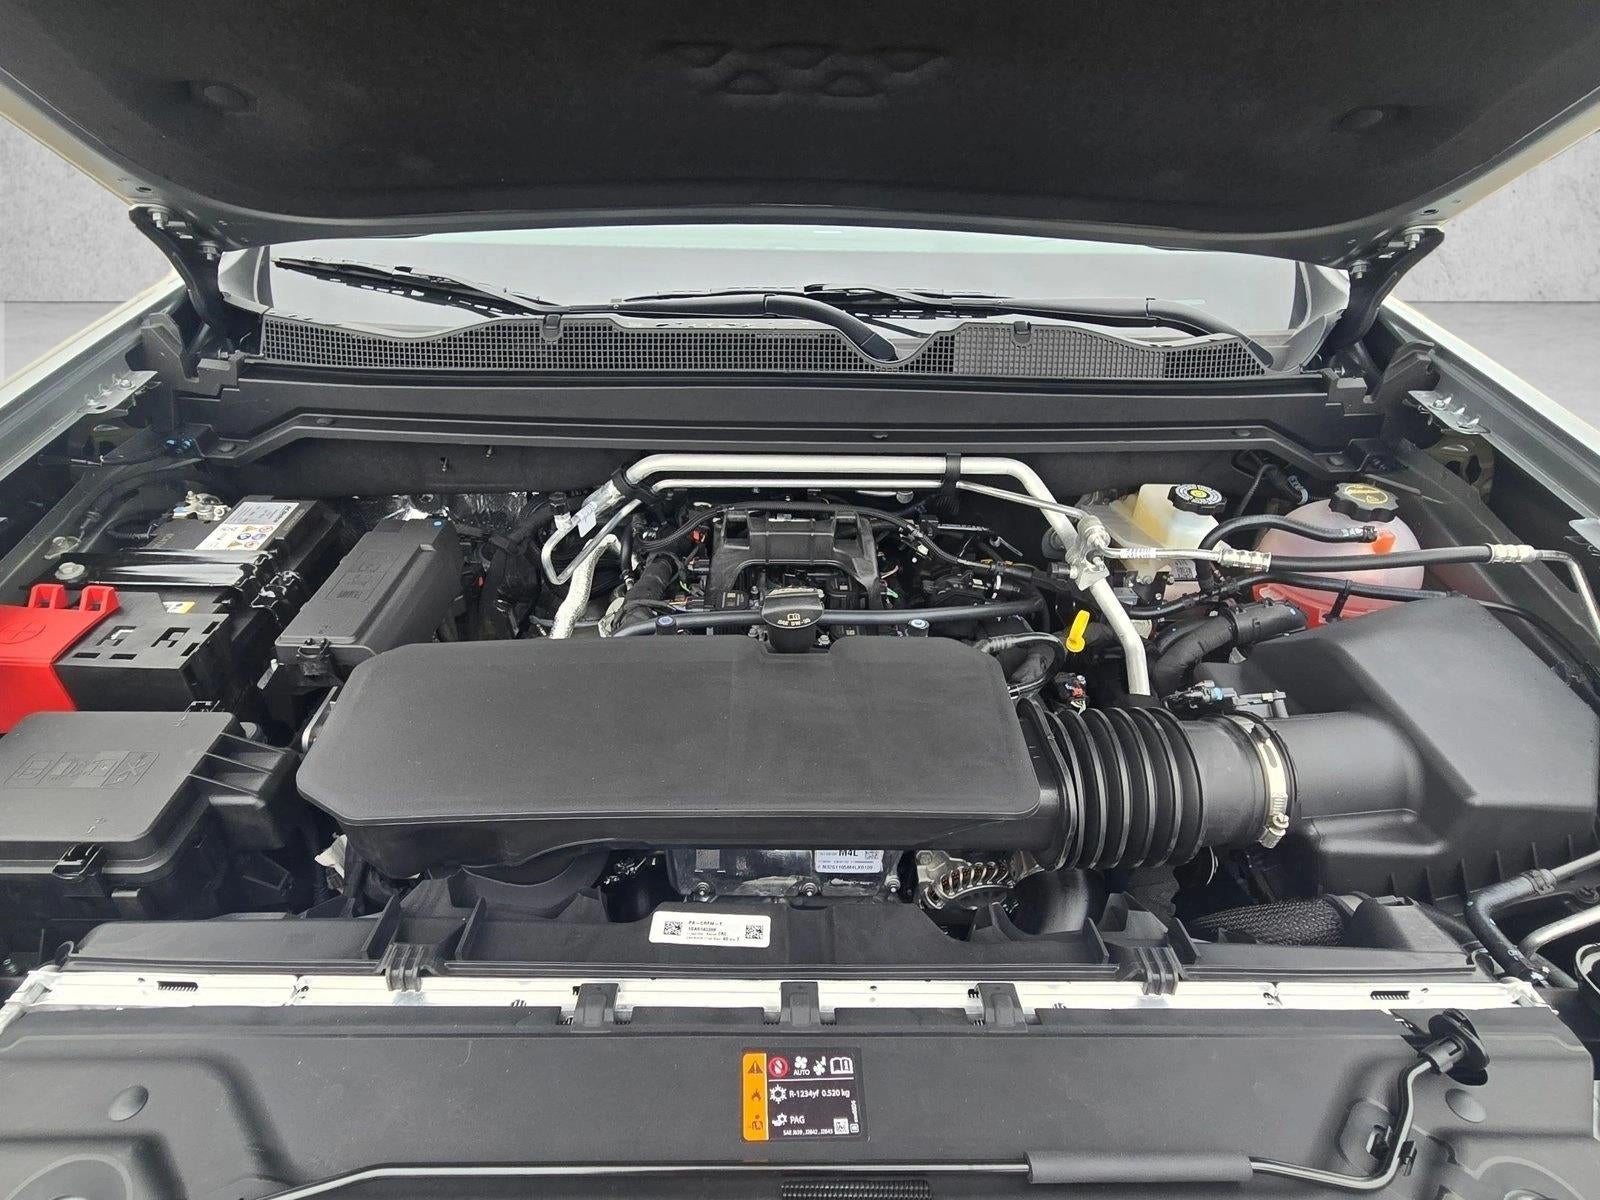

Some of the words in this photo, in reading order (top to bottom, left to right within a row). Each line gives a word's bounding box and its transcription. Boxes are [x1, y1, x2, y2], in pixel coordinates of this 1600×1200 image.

[789, 1089, 819, 1099] R-1234yf
[821, 1089, 841, 1097] 0.520
[841, 1088, 850, 1098] kg
[789, 1116, 806, 1124] PAG
